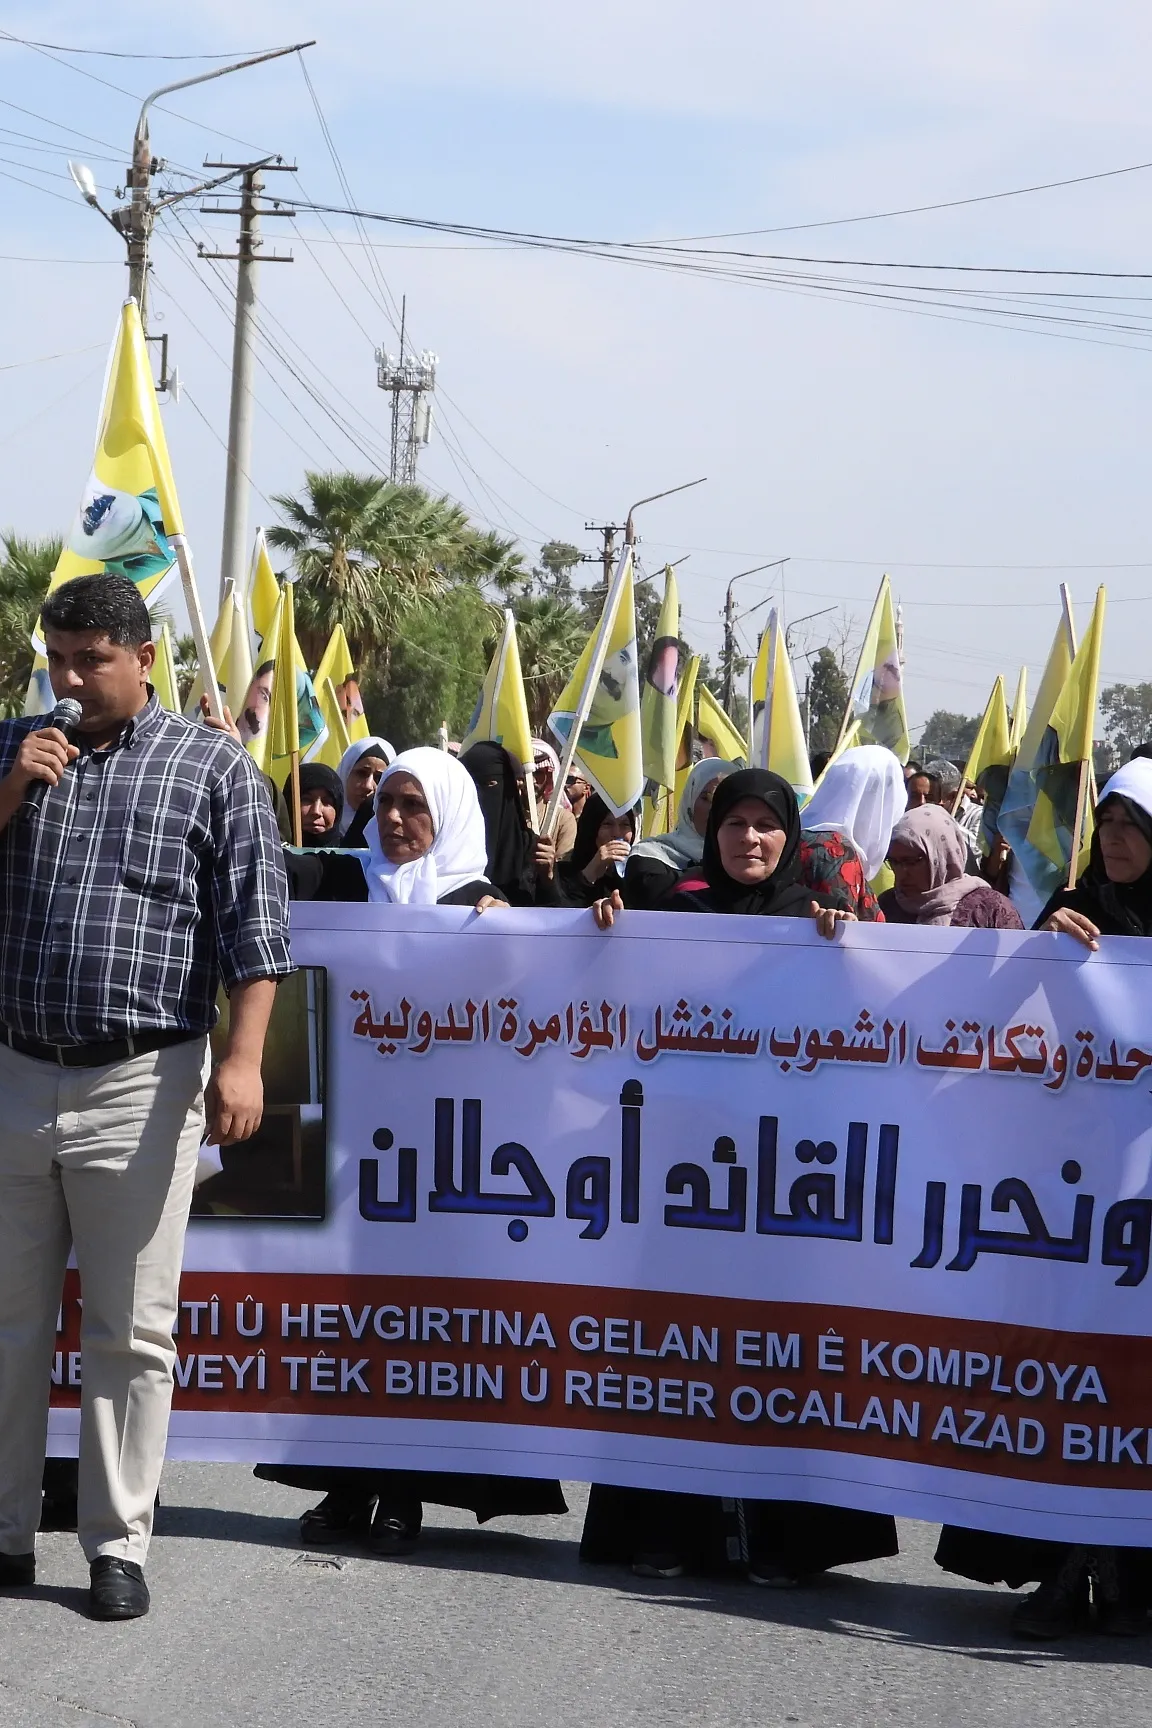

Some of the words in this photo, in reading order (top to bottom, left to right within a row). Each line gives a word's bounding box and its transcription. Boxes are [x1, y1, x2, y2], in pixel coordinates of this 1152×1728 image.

[350, 990, 489, 1054] الدولية
[498, 998, 627, 1058] المؤامرة
[637, 998, 760, 1061] سنفشل
[769, 1009, 906, 1072] الشعوب
[916, 1018, 1067, 1089] وتكاتف
[359, 1079, 643, 1242] أوجلان
[664, 1116, 899, 1245] القائد
[910, 1160, 1152, 1287] ونحرر
[237, 1295, 262, 1336] Û
[282, 1303, 556, 1347] HEVGIRTINA
[569, 1316, 718, 1361] GELAN
[736, 1330, 799, 1367] EM
[819, 1328, 843, 1371] Ê
[861, 1339, 1108, 1403] KOMPLOYA
[281, 1350, 369, 1392] TÊK
[386, 1360, 502, 1398] BIBIN
[521, 1360, 547, 1401] Û
[566, 1366, 715, 1417] RÊBER
[731, 1386, 919, 1437] OCALAN
[932, 1406, 1044, 1454] AZAD
